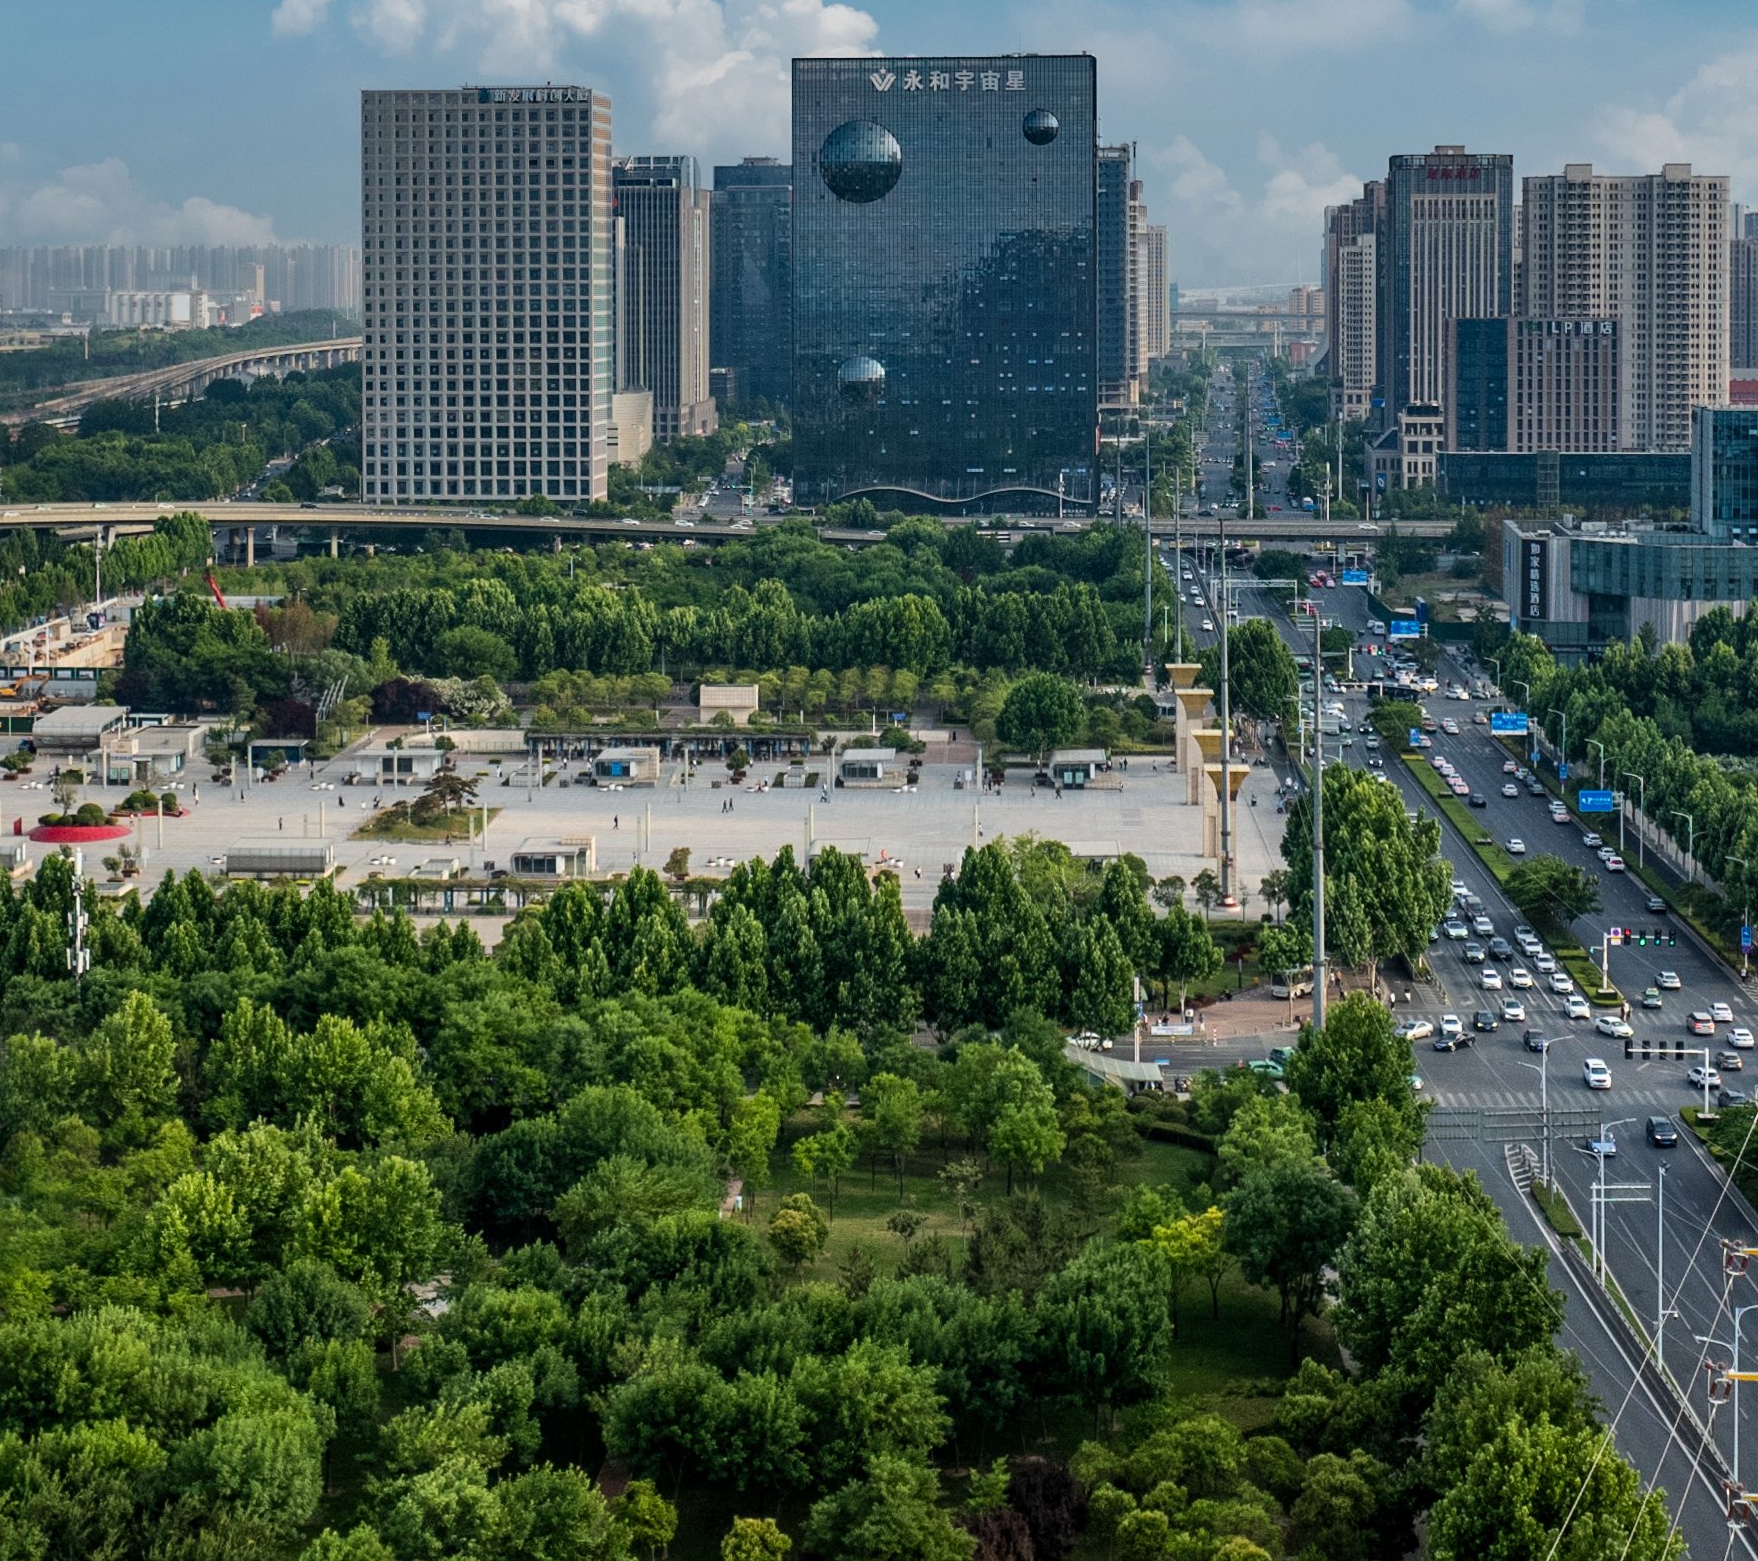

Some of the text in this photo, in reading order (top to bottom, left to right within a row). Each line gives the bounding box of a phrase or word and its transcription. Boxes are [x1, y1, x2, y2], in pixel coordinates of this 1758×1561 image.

[903, 69, 1026, 92] 永和宇宙星
[1551, 321, 1613, 335] LP酒店
